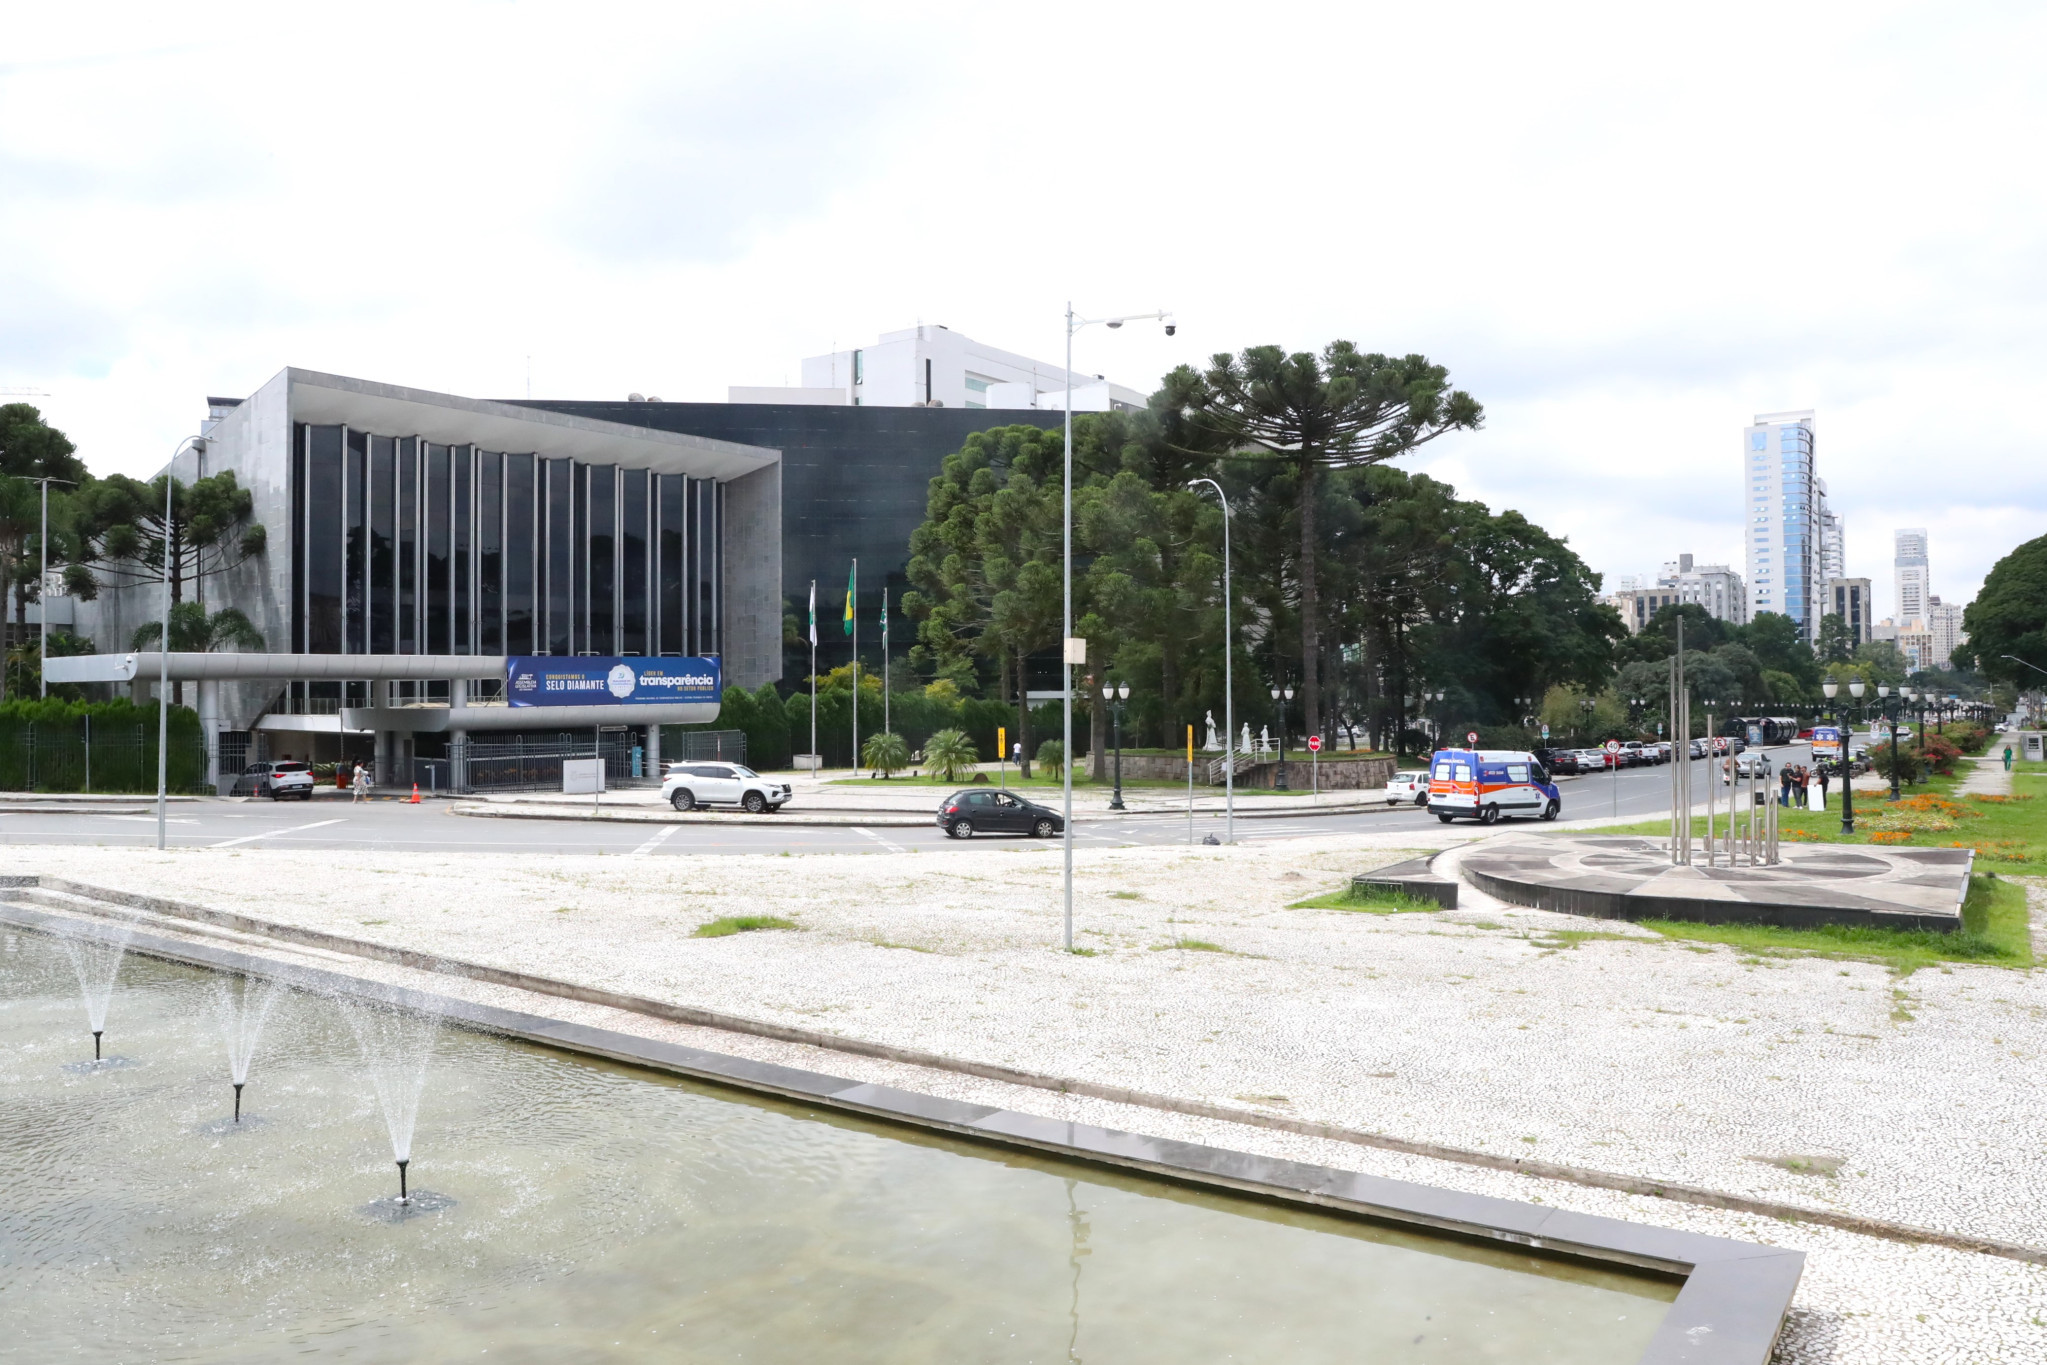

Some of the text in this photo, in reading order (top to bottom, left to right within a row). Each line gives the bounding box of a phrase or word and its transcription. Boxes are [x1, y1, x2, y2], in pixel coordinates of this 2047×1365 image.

[546, 680, 565, 691] SELO
[567, 680, 605, 690] DIAMANTE
[639, 674, 714, 688] transparência
[1608, 741, 1618, 750] 40
